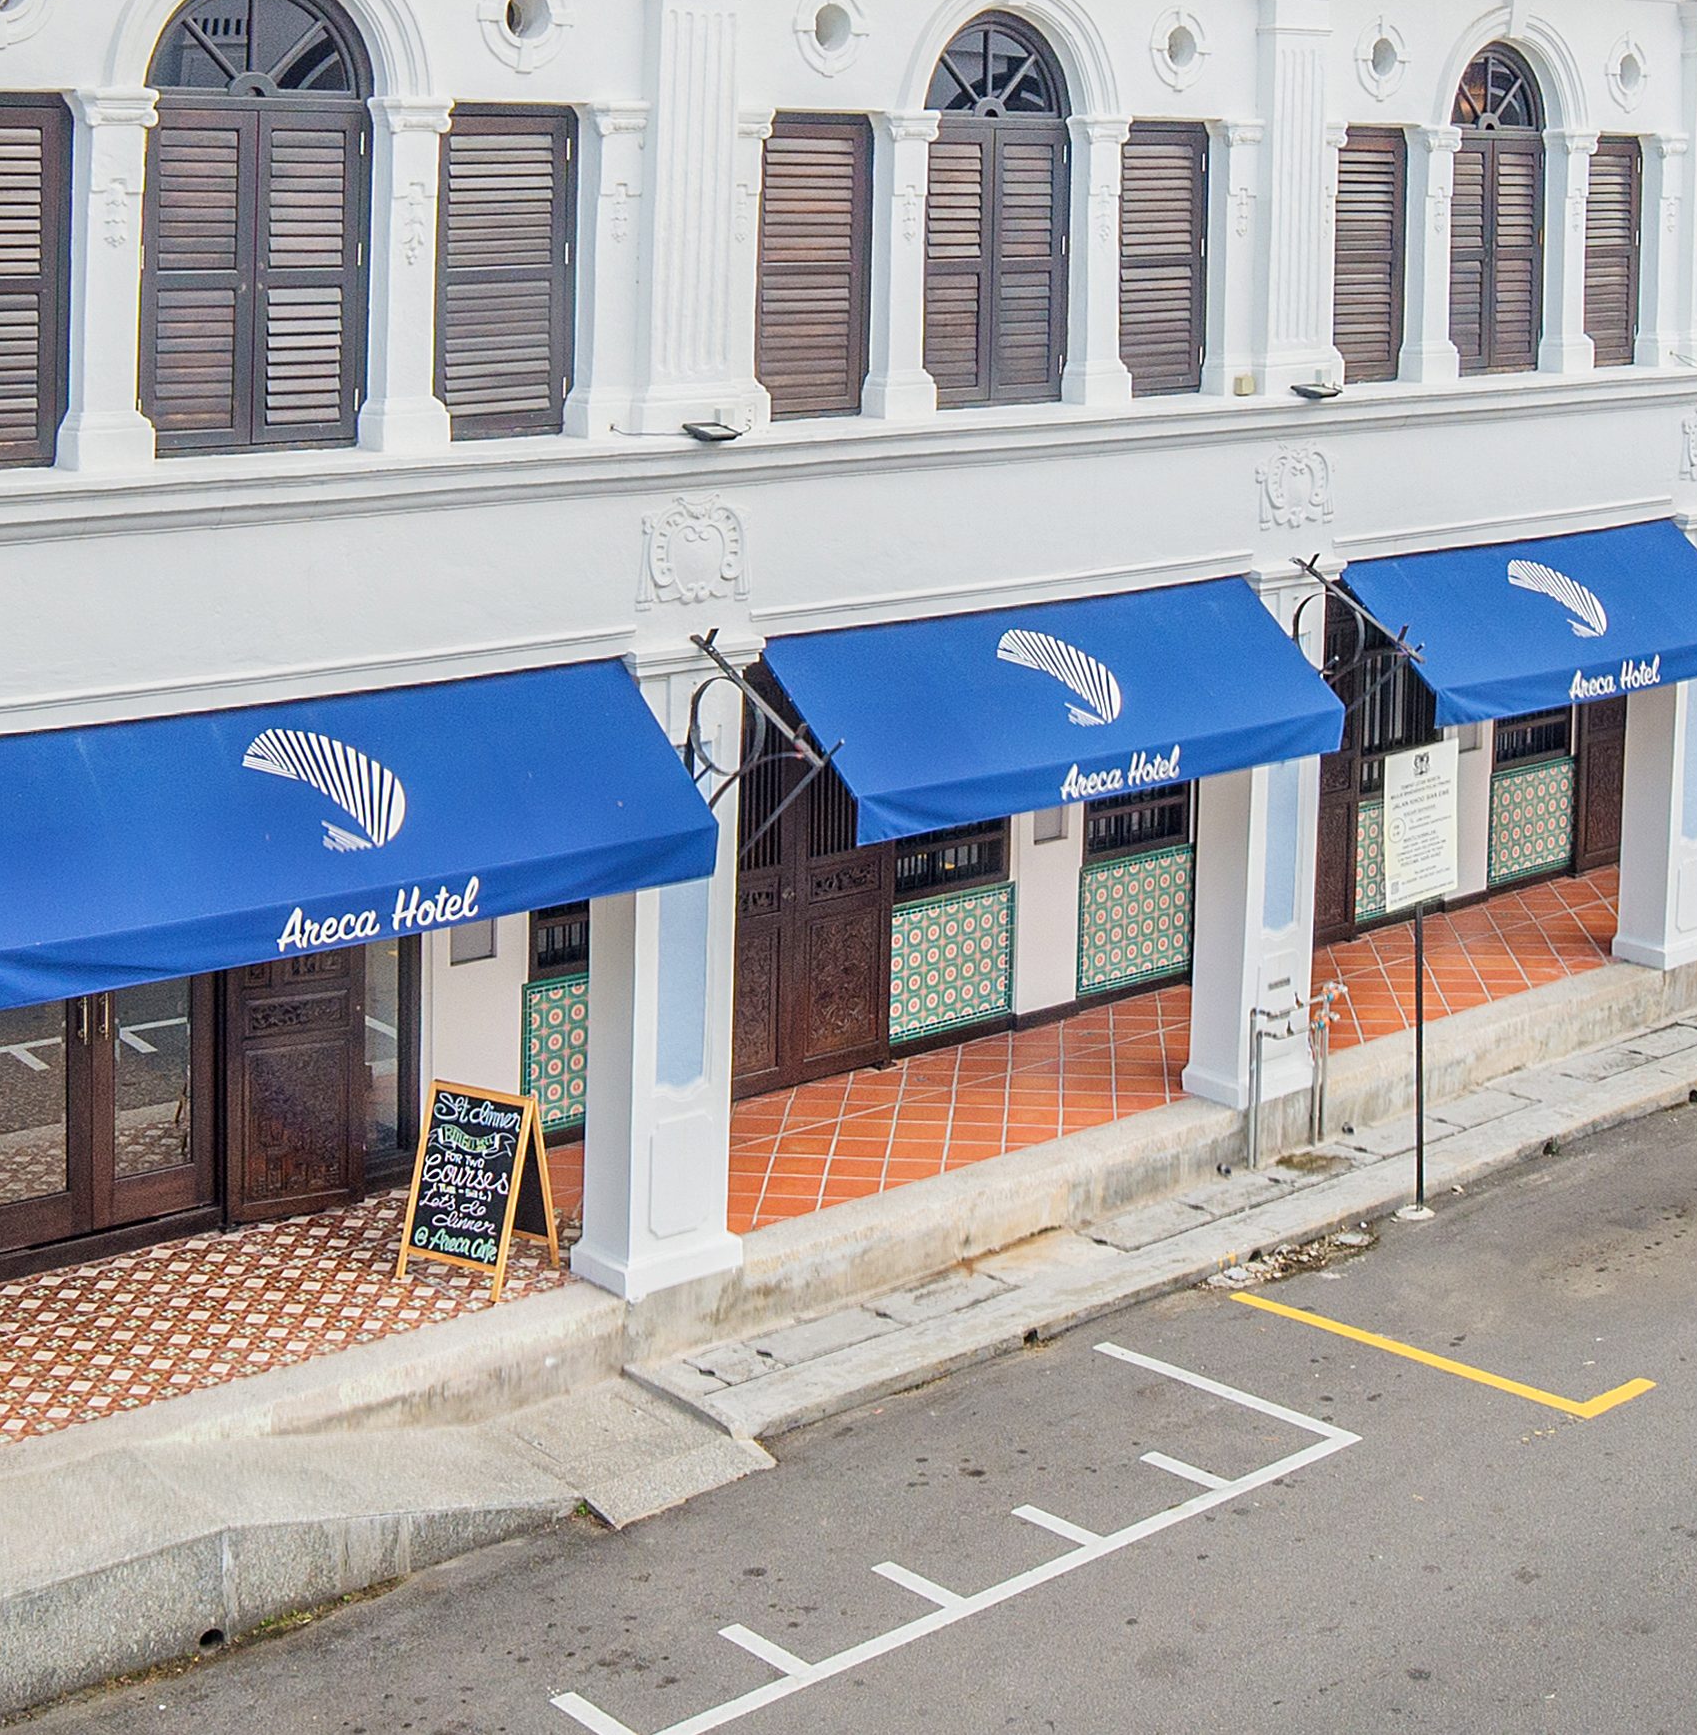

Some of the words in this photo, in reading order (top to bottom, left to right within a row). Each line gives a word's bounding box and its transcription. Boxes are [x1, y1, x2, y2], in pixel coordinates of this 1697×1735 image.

[1568, 669, 1616, 701] Areca
[1620, 653, 1661, 690] Hotel
[1060, 763, 1124, 802] Areca
[1127, 744, 1181, 787] Hotel
[276, 906, 381, 952] Areca
[391, 875, 480, 931] Hotel
[434, 1092, 471, 1124] Set
[469, 1101, 521, 1133] dinner
[422, 1153, 509, 1196] Courses
[445, 1151, 463, 1164] FOR
[465, 1154, 485, 1168] TWO
[418, 1186, 456, 1212] Let's
[459, 1200, 487, 1217] do
[414, 1226, 429, 1246] @
[428, 1228, 471, 1256] Areca
[431, 1210, 498, 1236] dinner
